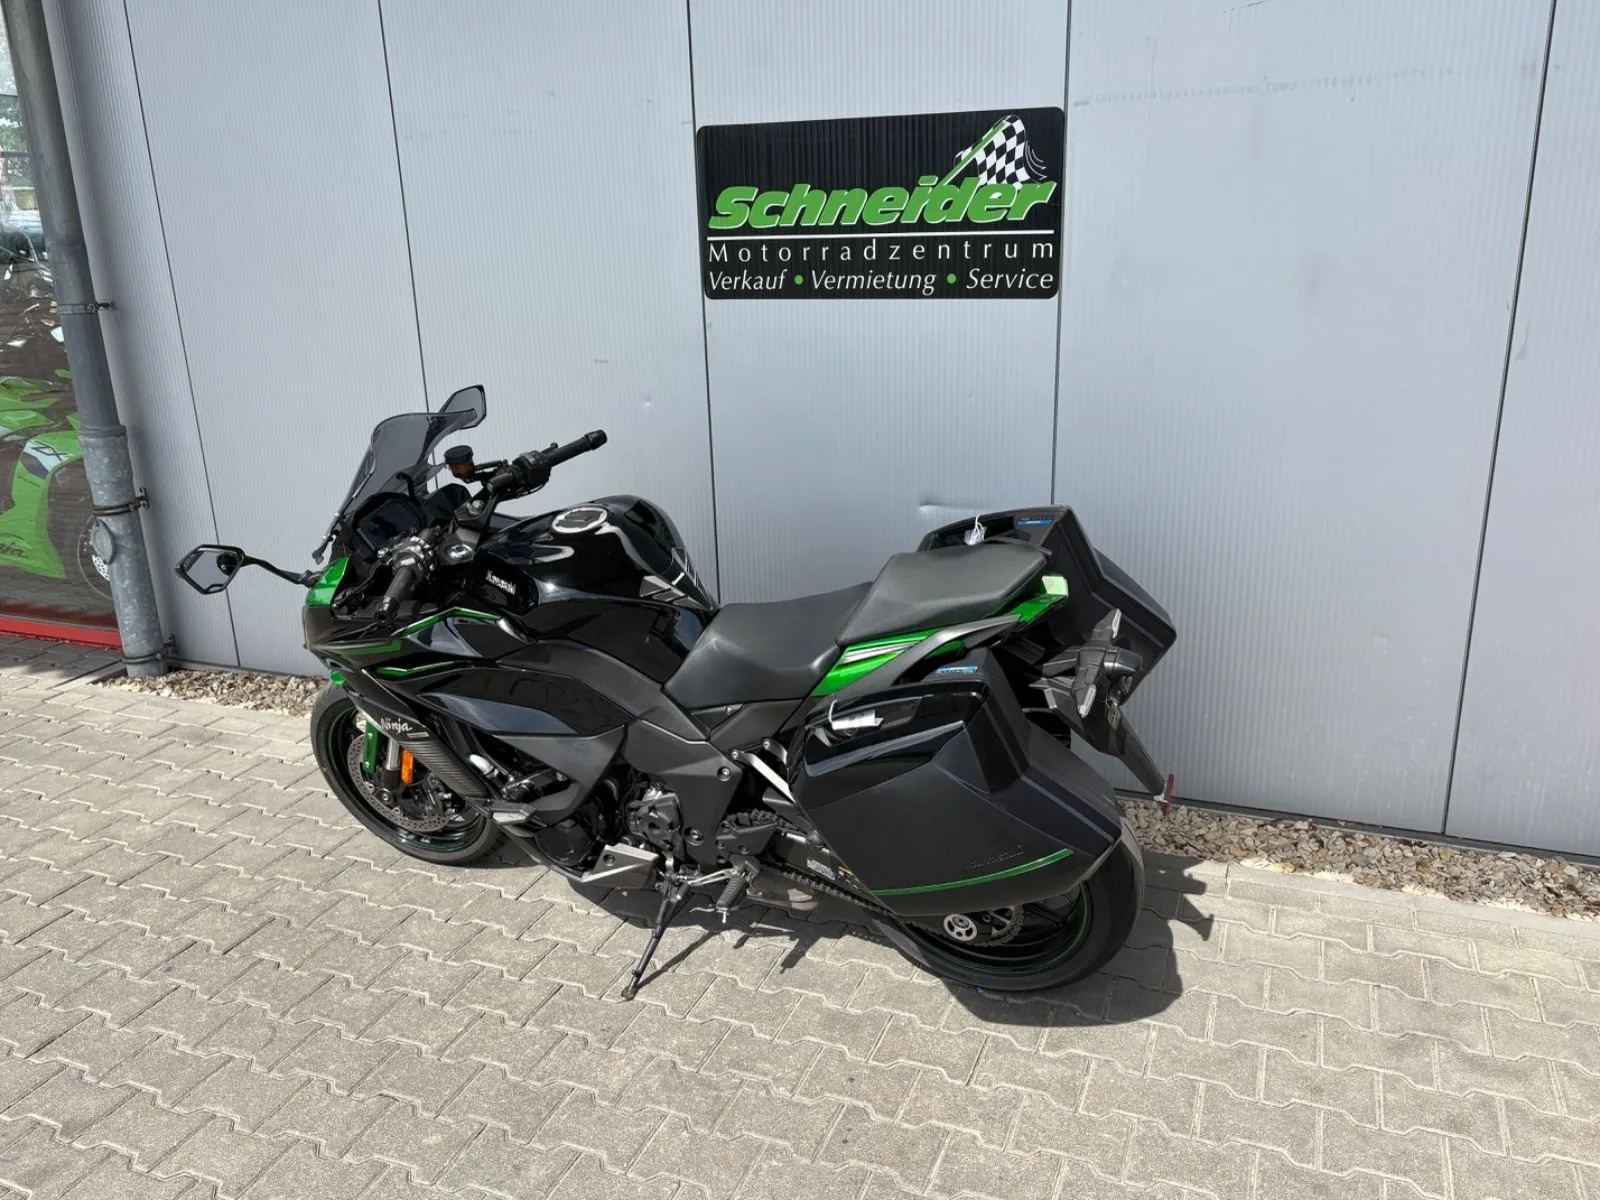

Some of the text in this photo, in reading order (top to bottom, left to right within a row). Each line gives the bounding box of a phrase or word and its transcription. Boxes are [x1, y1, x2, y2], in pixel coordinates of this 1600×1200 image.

[708, 175, 1056, 230] Schneider
[708, 238, 1054, 263] Motorradzentrum
[708, 267, 1054, 296] Verkauf Vermietung Service
[380, 717, 413, 735] Ninja
